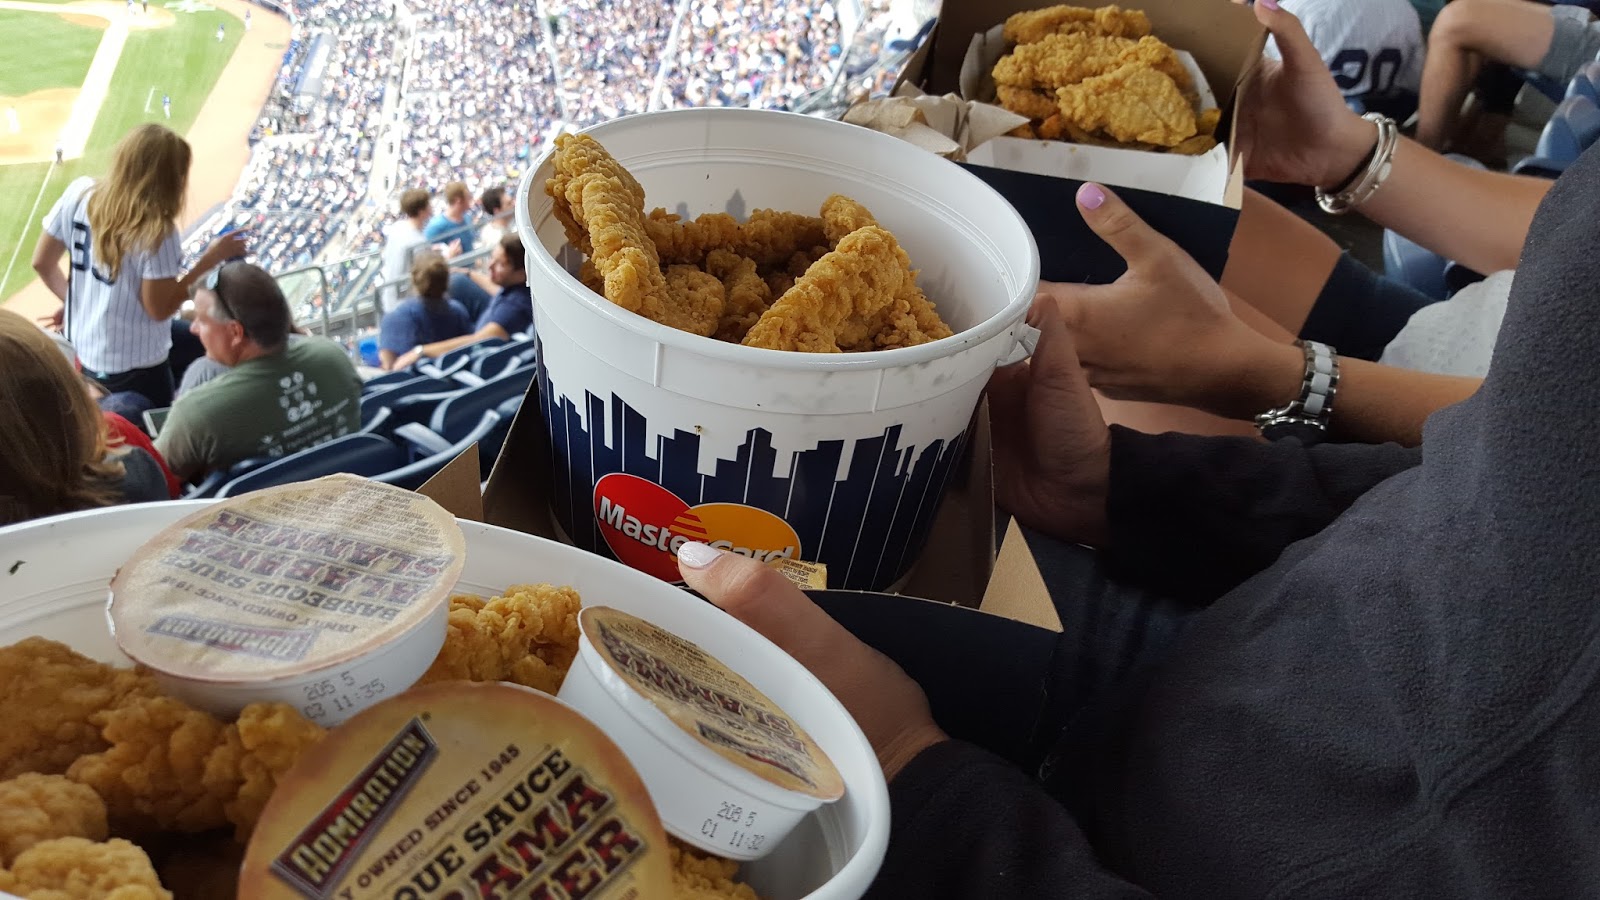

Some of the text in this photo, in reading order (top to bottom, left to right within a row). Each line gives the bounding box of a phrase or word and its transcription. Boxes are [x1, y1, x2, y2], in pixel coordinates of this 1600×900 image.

[209, 511, 444, 581] SLAMMER
[599, 495, 795, 563] Masterd
[178, 534, 427, 603] ALABAMA
[253, 579, 401, 621] BARBEQUE
[341, 671, 355, 686] 5
[290, 732, 426, 883] ADMIRATION
[357, 829, 423, 889] OWNED
[424, 778, 481, 831] SINCE
[463, 749, 572, 851] SAUCE
